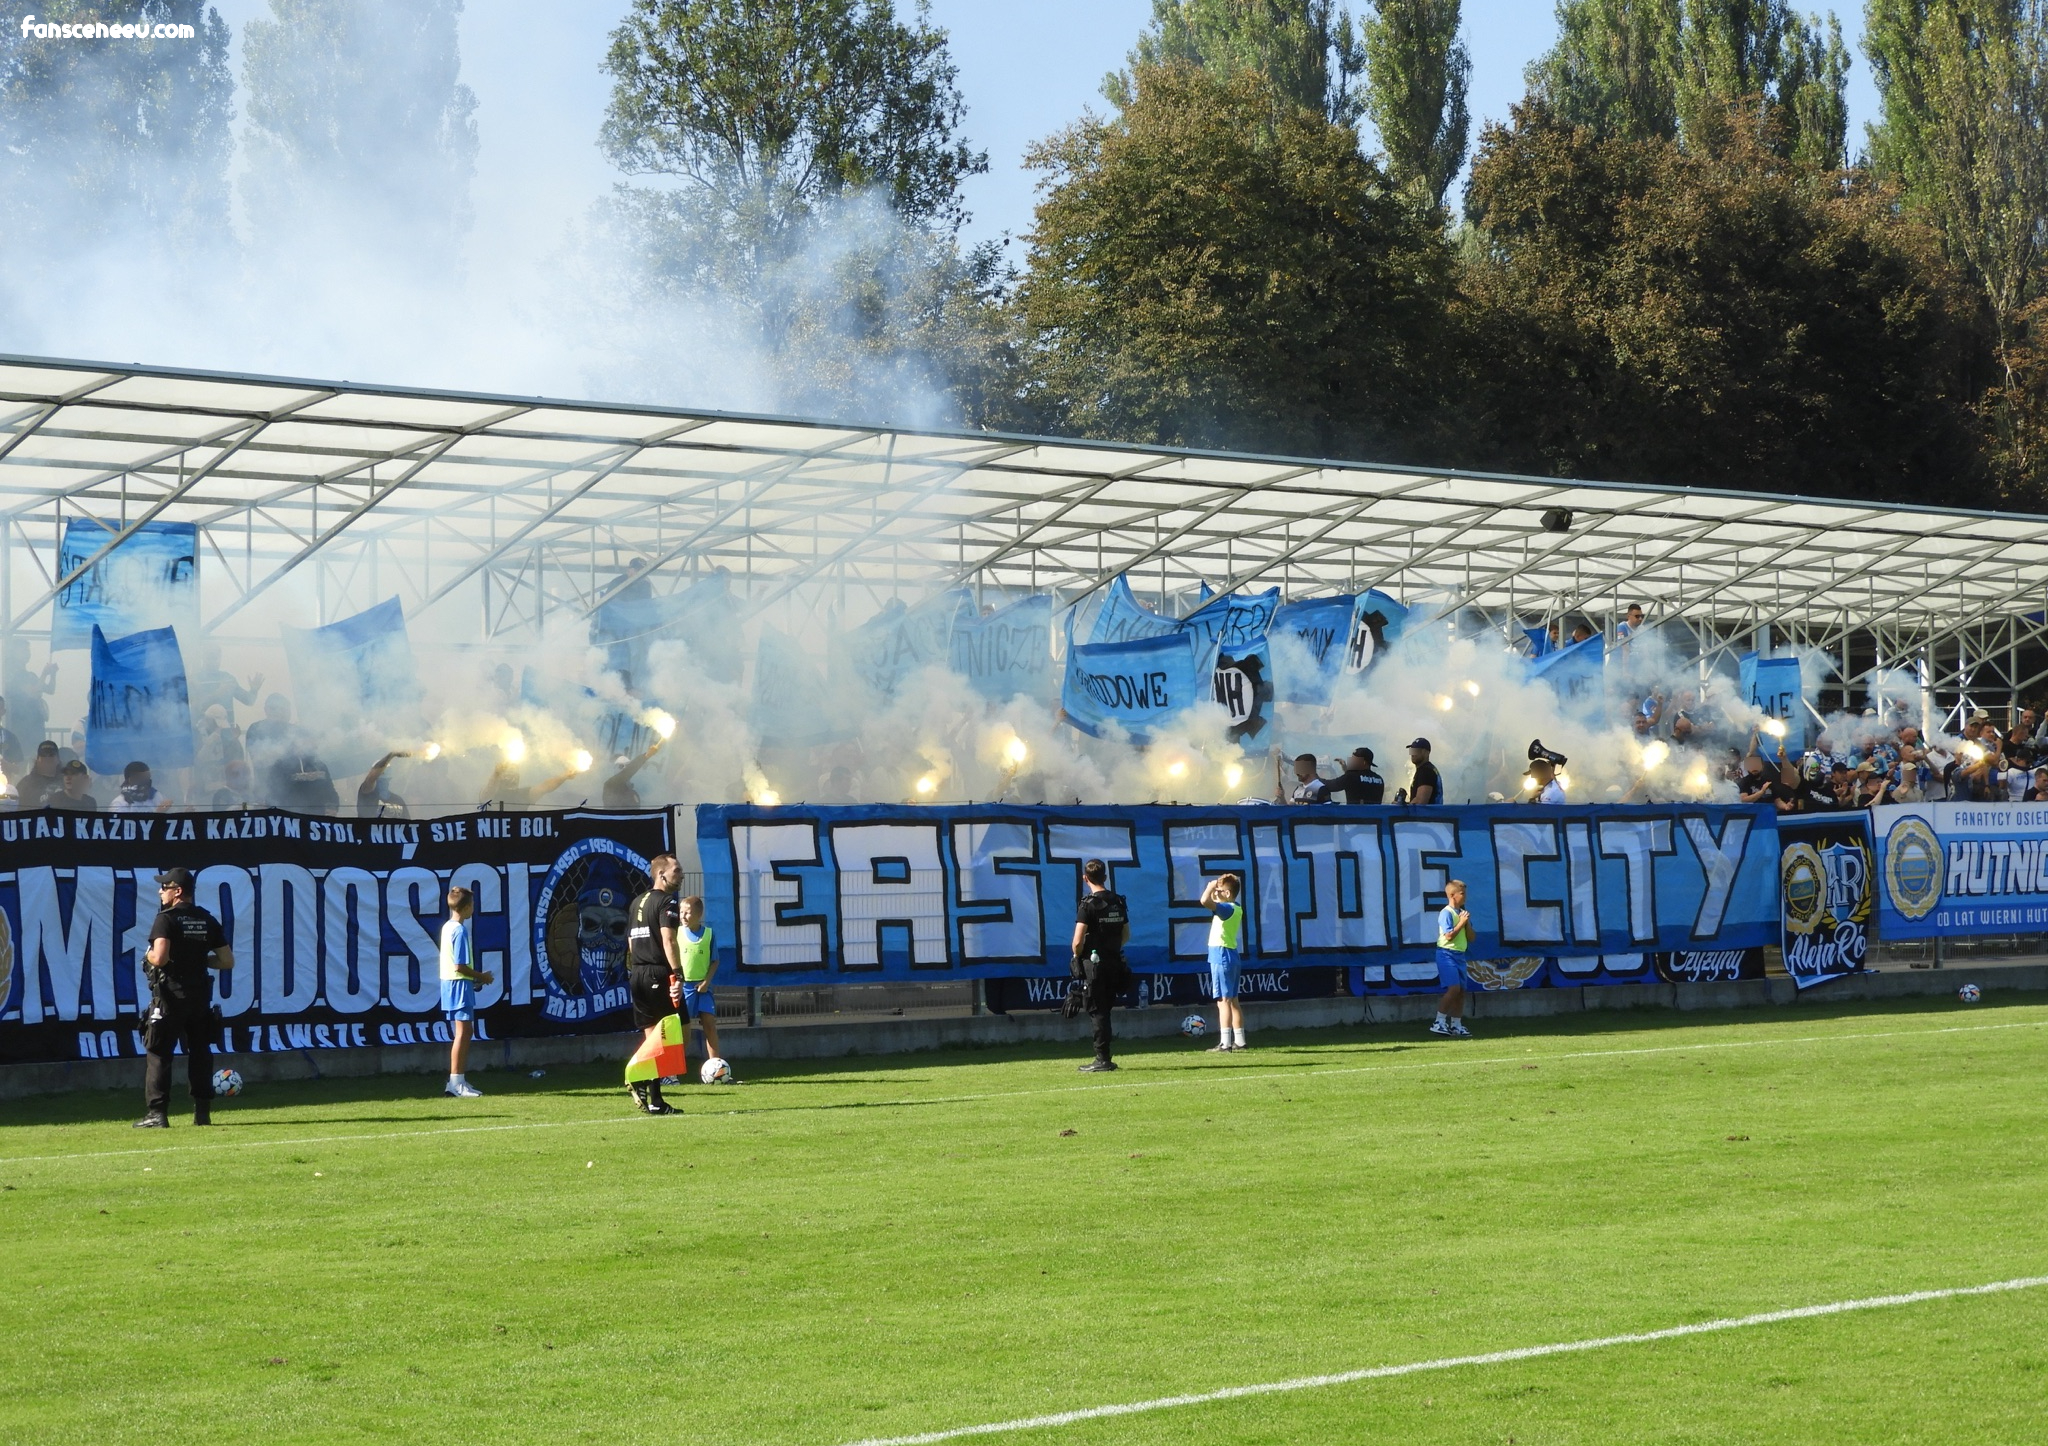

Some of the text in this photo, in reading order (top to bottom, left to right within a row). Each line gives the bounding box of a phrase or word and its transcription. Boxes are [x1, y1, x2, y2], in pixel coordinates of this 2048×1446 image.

[2, 816, 65, 842] UTAJ
[75, 813, 154, 841] KAŻDY
[165, 819, 196, 841] ZA
[206, 812, 301, 841] KAŻDYM
[309, 820, 363, 845] STOI,
[370, 823, 420, 844] NIKT
[477, 817, 512, 839] NIE
[1955, 810, 2048, 827] FANATYCY OSIED
[1945, 839, 2048, 897] HUTNIC
[728, 816, 1141, 972] EAST
[1162, 816, 1463, 960] SIDE
[1489, 813, 1757, 946] CITY
[1937, 907, 2048, 928] OD LAT WIERNI HUT
[1153, 973, 1174, 1000] BY
[1196, 970, 1290, 997] WRYWAĆ
